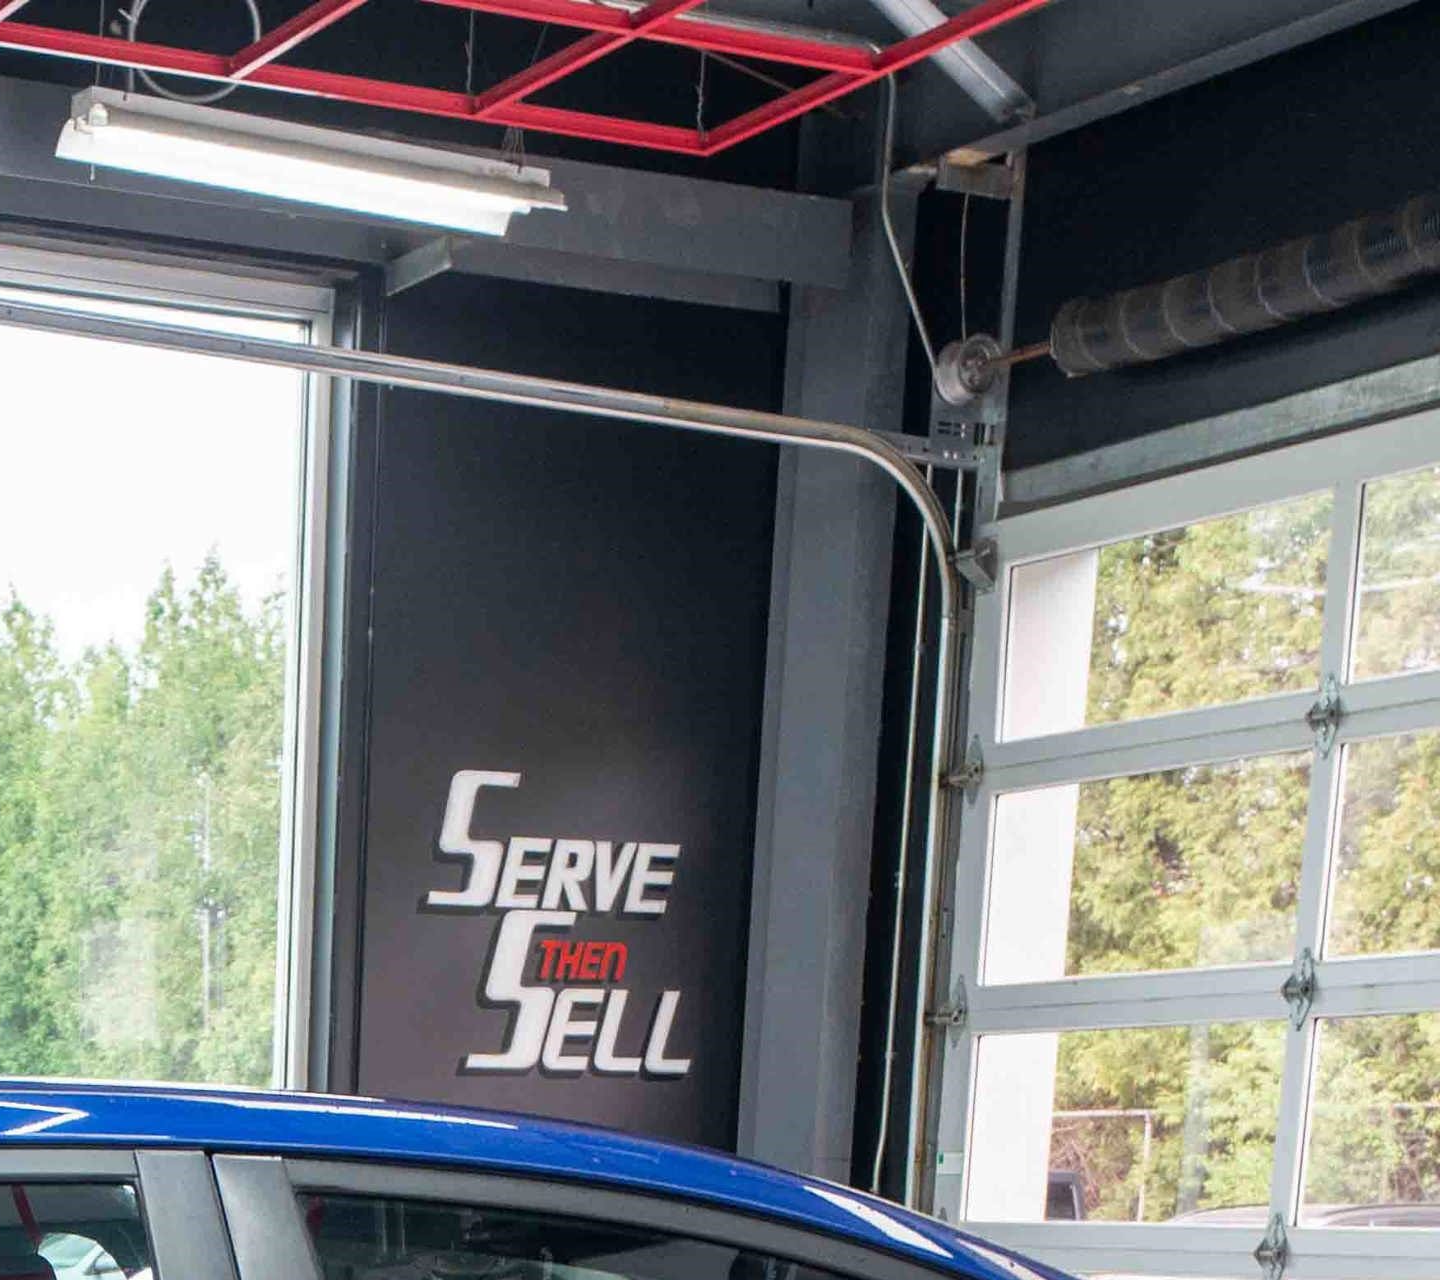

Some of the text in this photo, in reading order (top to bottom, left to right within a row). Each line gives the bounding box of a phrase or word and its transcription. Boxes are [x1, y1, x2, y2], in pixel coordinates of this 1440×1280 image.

[426, 769, 681, 914] SERVE
[465, 909, 692, 1074] SELL
[539, 939, 628, 981] THEN
